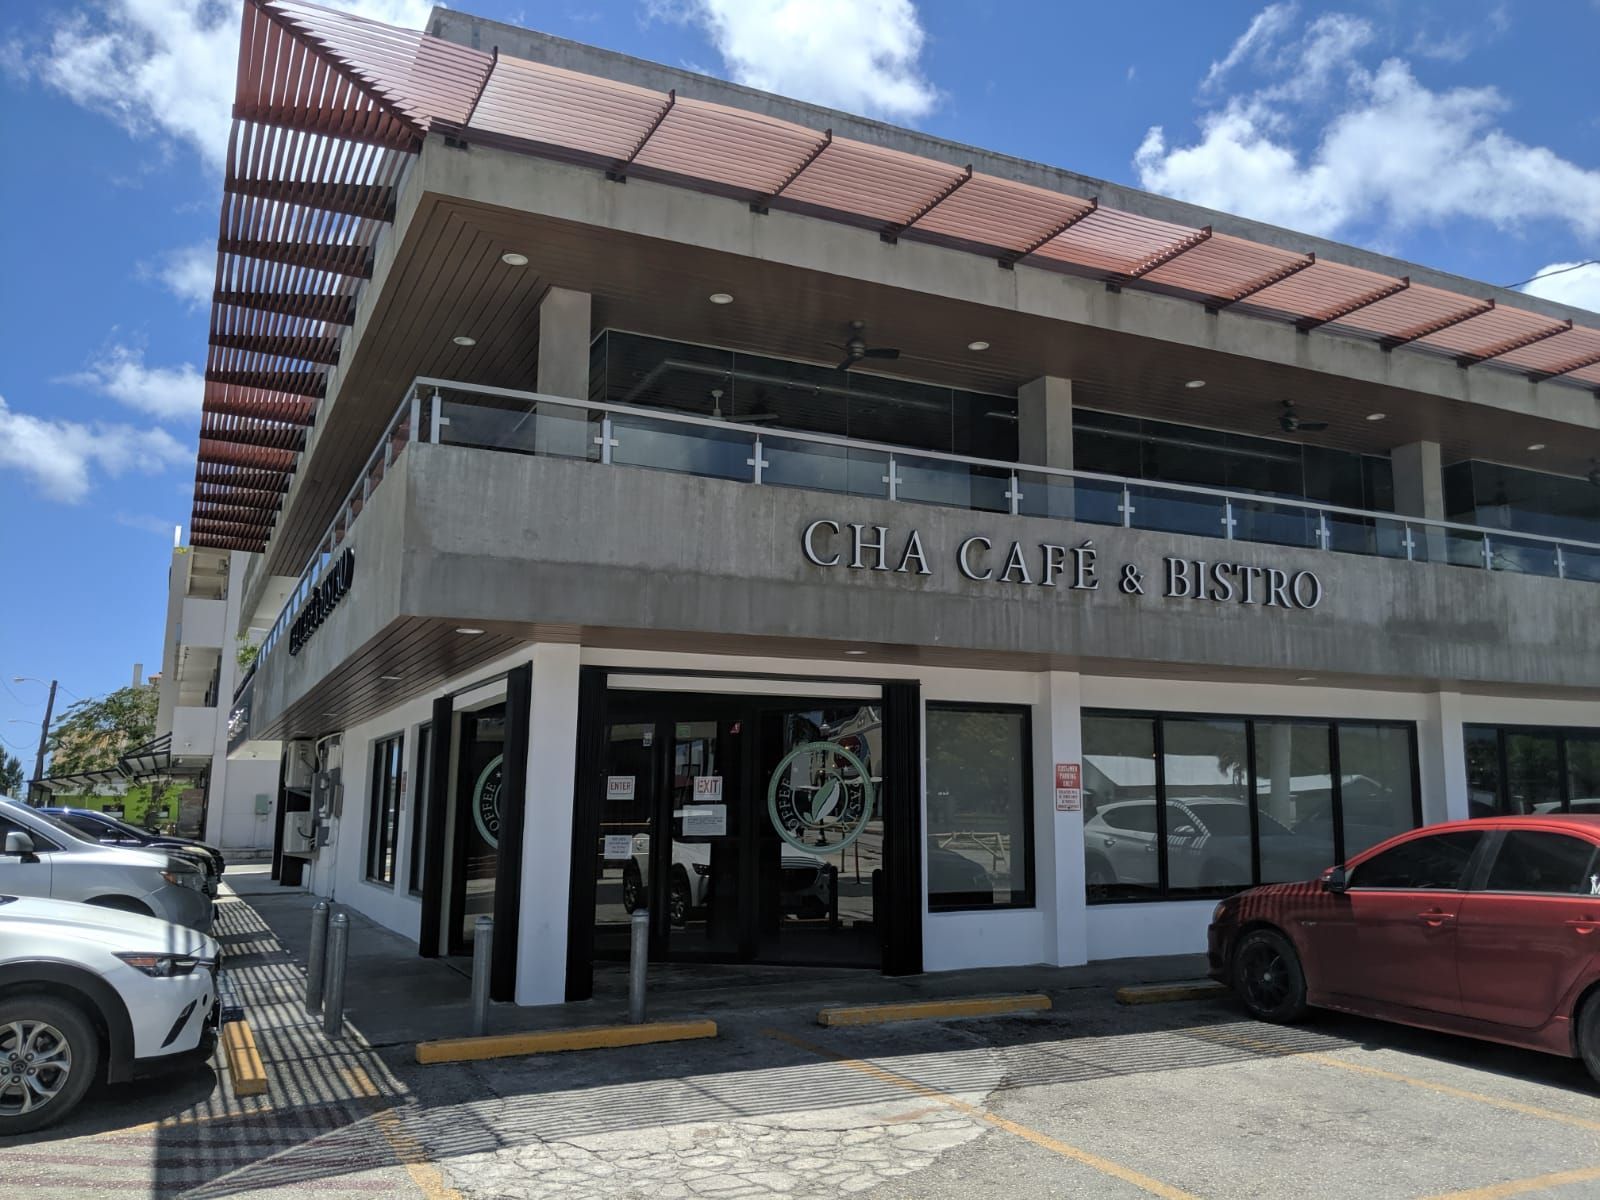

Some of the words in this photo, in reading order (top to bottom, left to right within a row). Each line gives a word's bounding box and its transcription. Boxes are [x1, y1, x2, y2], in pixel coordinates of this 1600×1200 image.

[801, 519, 933, 576] CHA
[957, 536, 1099, 591] CAFÉ
[1119, 563, 1145, 595] &
[1162, 556, 1323, 610] BISTRO
[610, 781, 631, 791] ENTER
[697, 779, 720, 794] EXIT
